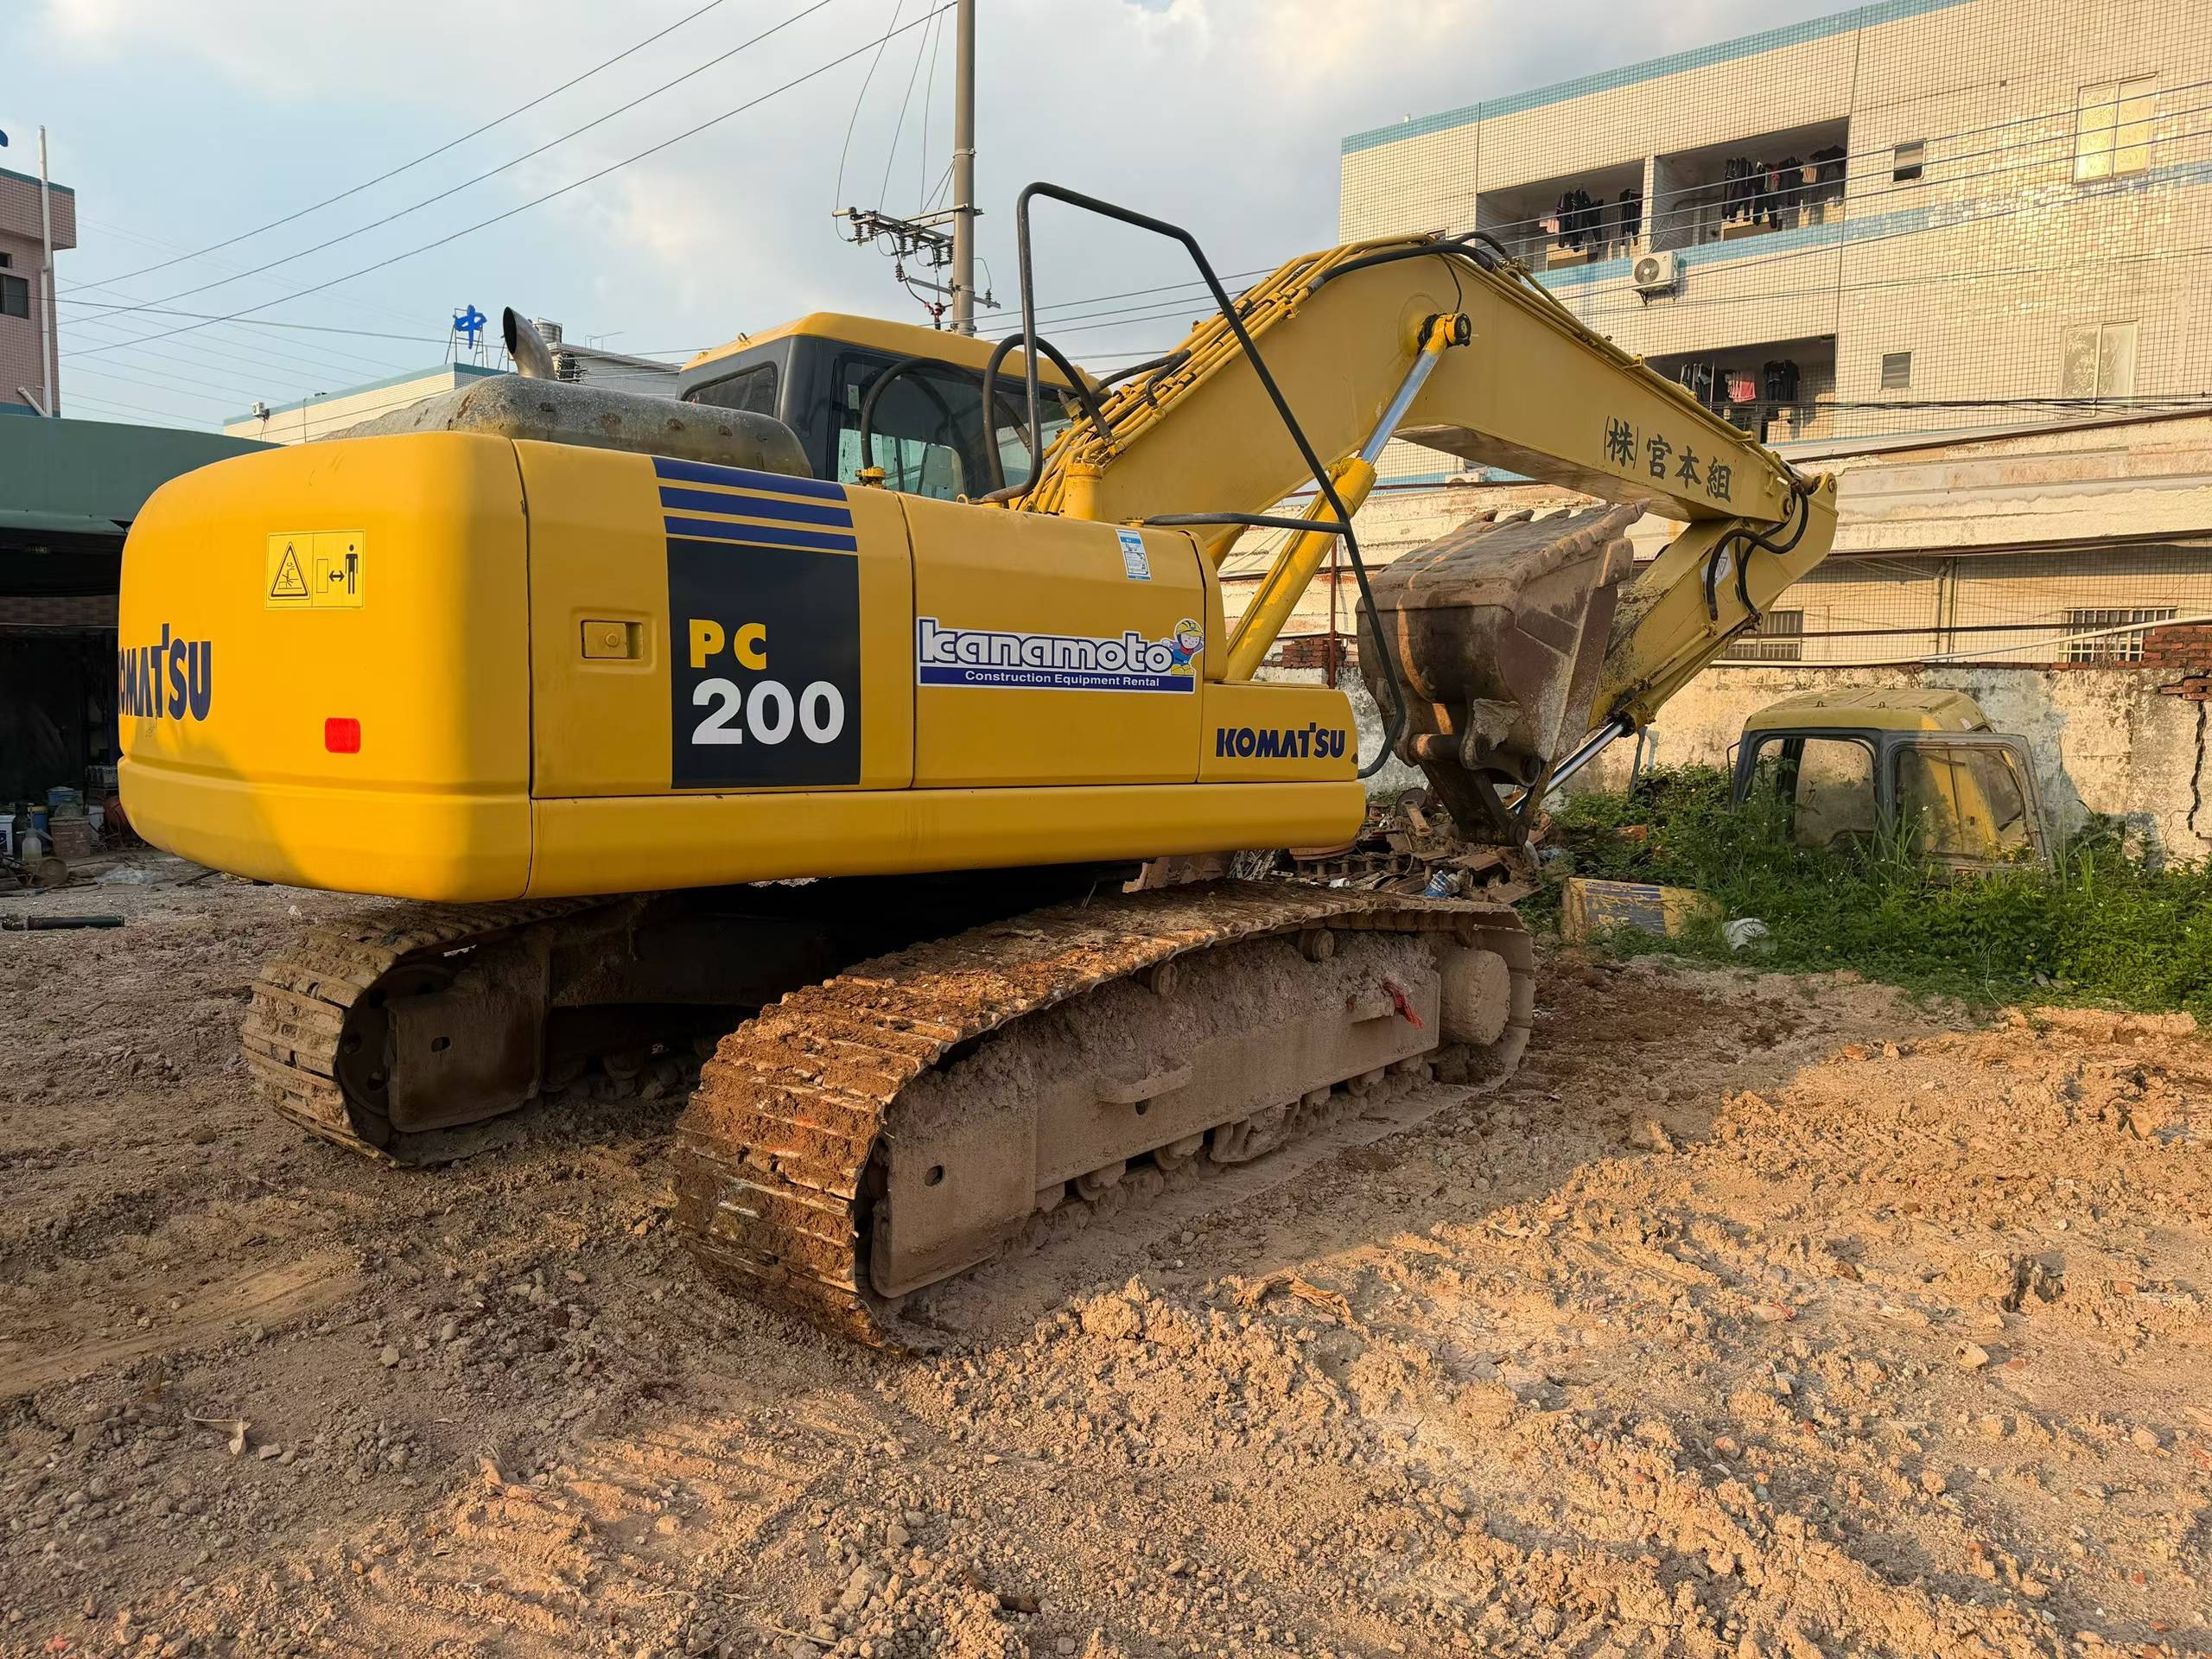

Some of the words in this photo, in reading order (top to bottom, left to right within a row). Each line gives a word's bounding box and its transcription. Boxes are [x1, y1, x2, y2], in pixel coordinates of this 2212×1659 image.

[690, 619, 767, 671] PC
[918, 619, 1173, 674] kanamoto
[118, 623, 212, 721] OMATSU
[965, 670, 1052, 683] Construction
[1054, 674, 1121, 686] Equipment
[1123, 677, 1160, 687] Rental
[691, 677, 845, 745] 200
[1216, 722, 1345, 758] KOMATSU
